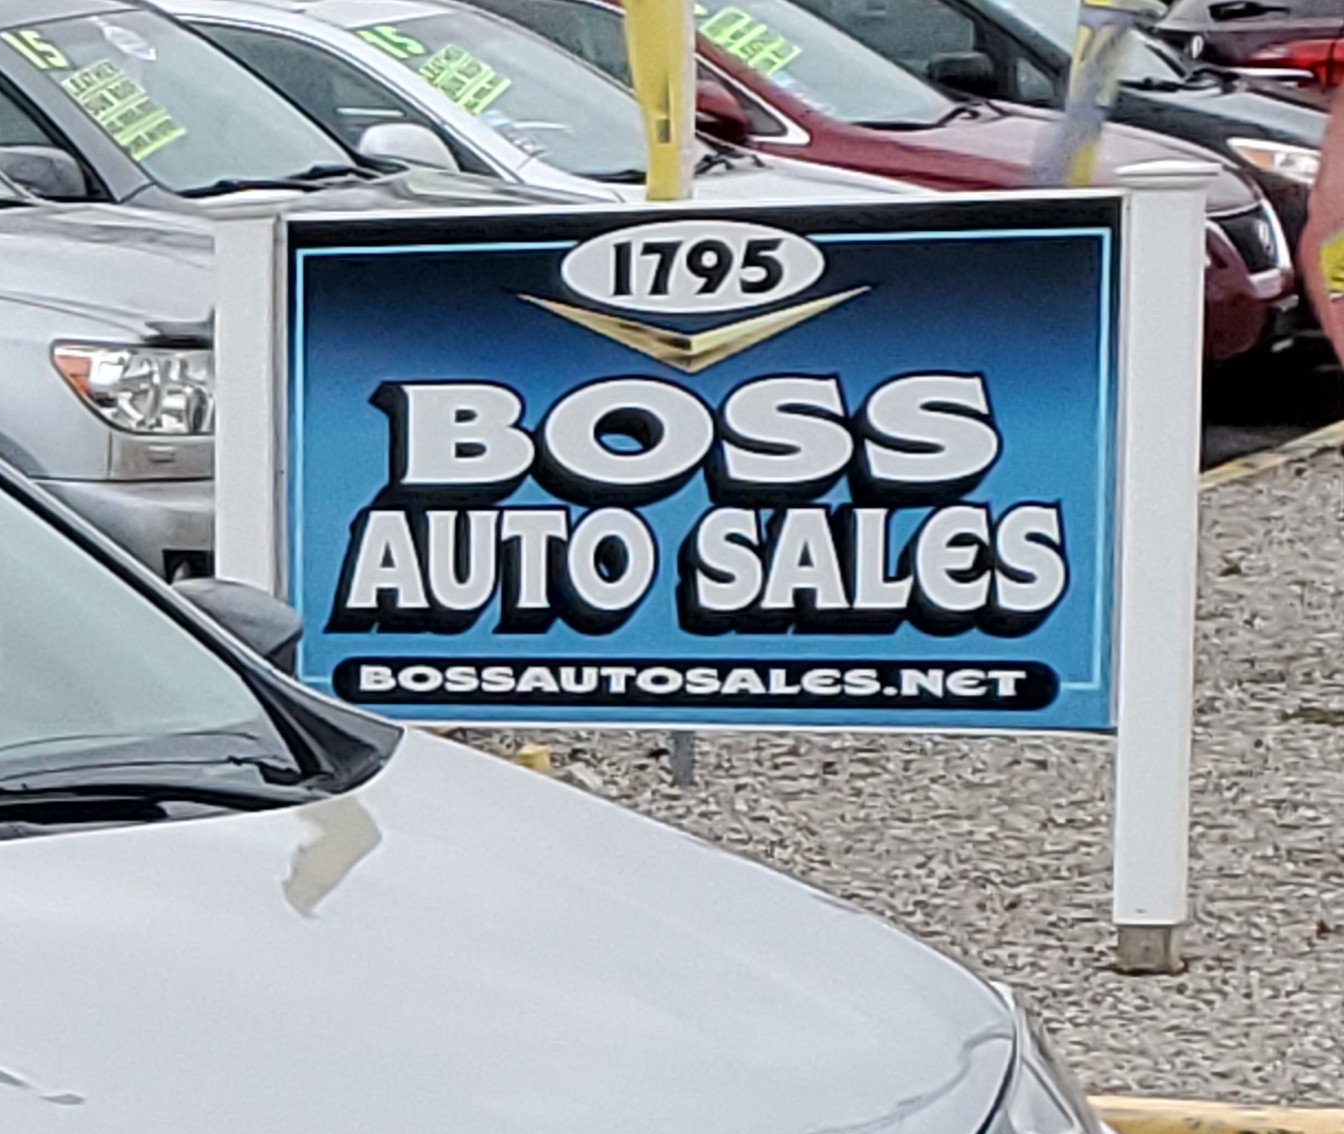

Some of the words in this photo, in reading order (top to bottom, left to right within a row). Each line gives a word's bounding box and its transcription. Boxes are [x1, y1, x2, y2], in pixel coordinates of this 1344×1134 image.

[0, 30, 70, 69] 15
[612, 239, 784, 296] 1795
[402, 377, 999, 484] BOSS
[347, 509, 653, 609] AUTO
[698, 507, 1064, 610] SALES
[360, 664, 1026, 697] BOSSAUTOSALES.NET
